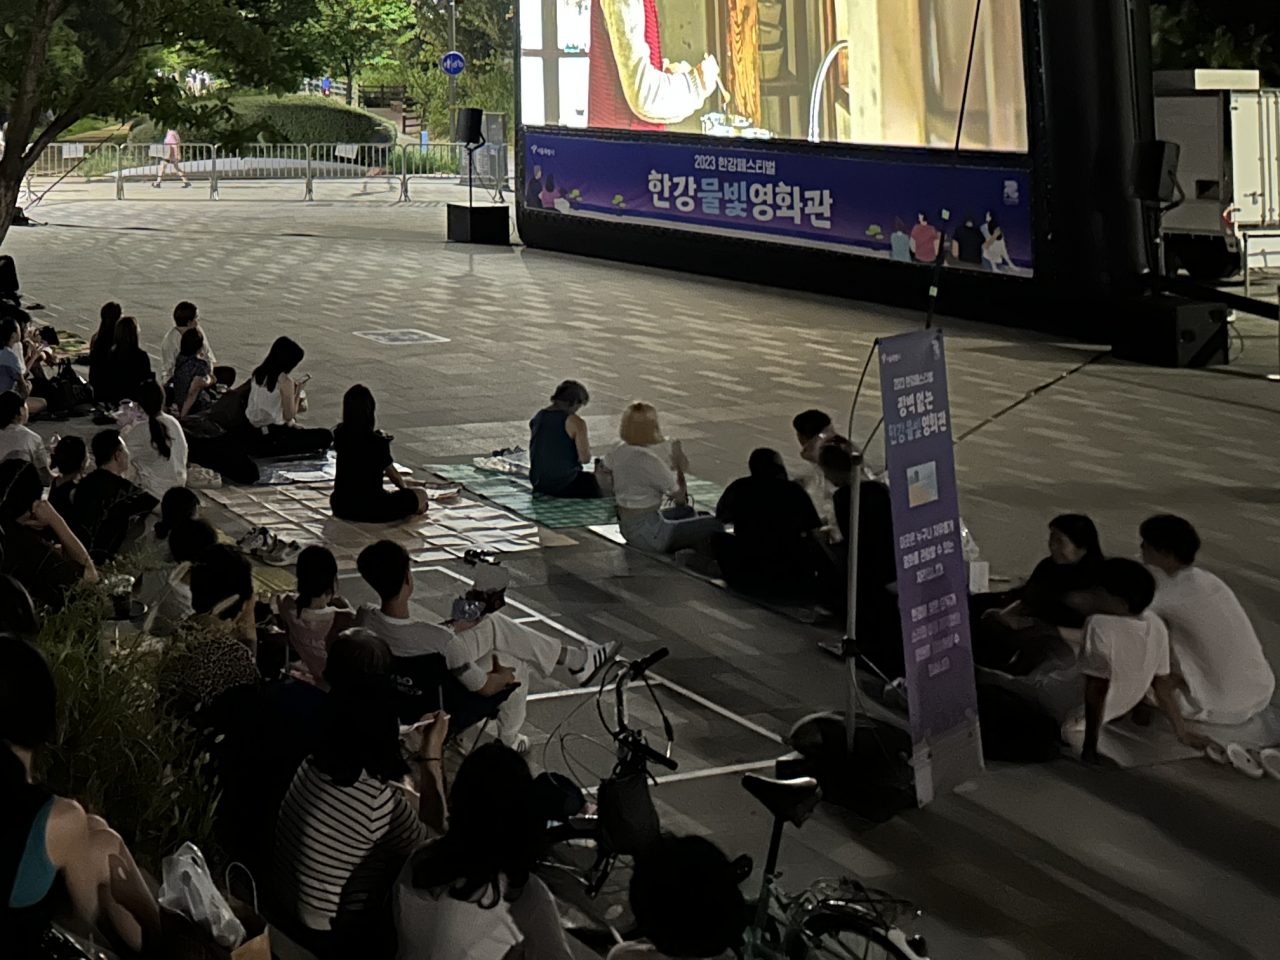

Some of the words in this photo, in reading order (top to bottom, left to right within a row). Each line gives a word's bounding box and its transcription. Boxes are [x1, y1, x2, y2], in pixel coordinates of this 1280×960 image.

[694, 155, 716, 170] 2023
[718, 157, 776, 176] 한강페스티벌
[648, 170, 833, 229] 한강물빛영화관
